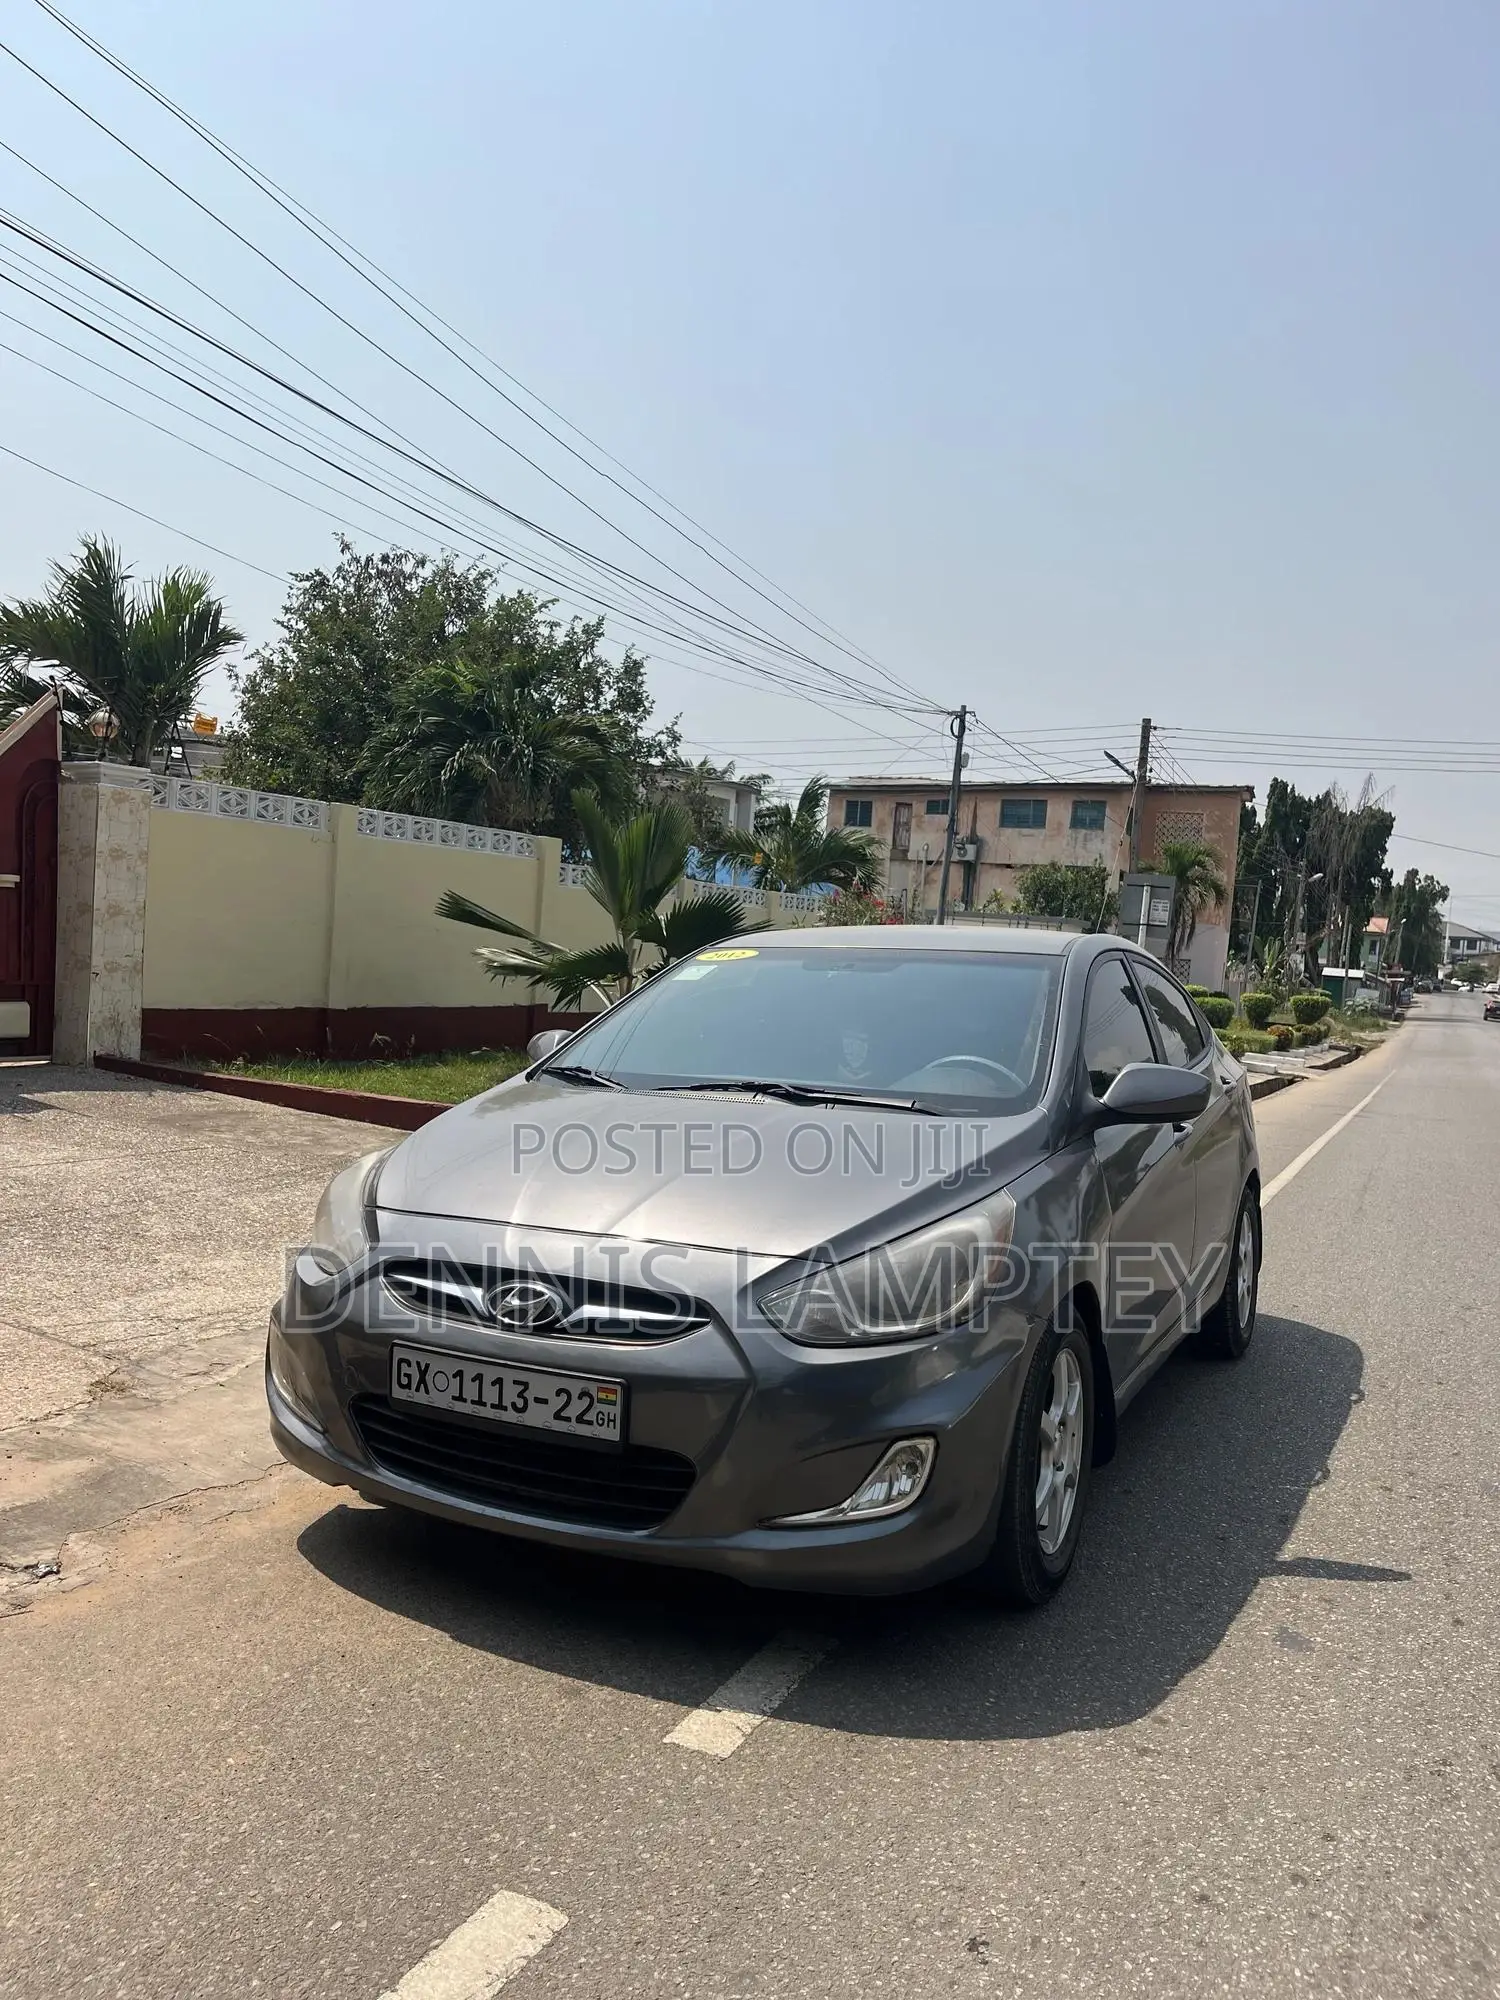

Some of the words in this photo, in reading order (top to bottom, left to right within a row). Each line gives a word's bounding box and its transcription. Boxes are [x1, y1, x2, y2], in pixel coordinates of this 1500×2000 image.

[396, 1357, 431, 1396] GX
[451, 1369, 594, 1426] 1113-22
[595, 1410, 617, 1430] GH
